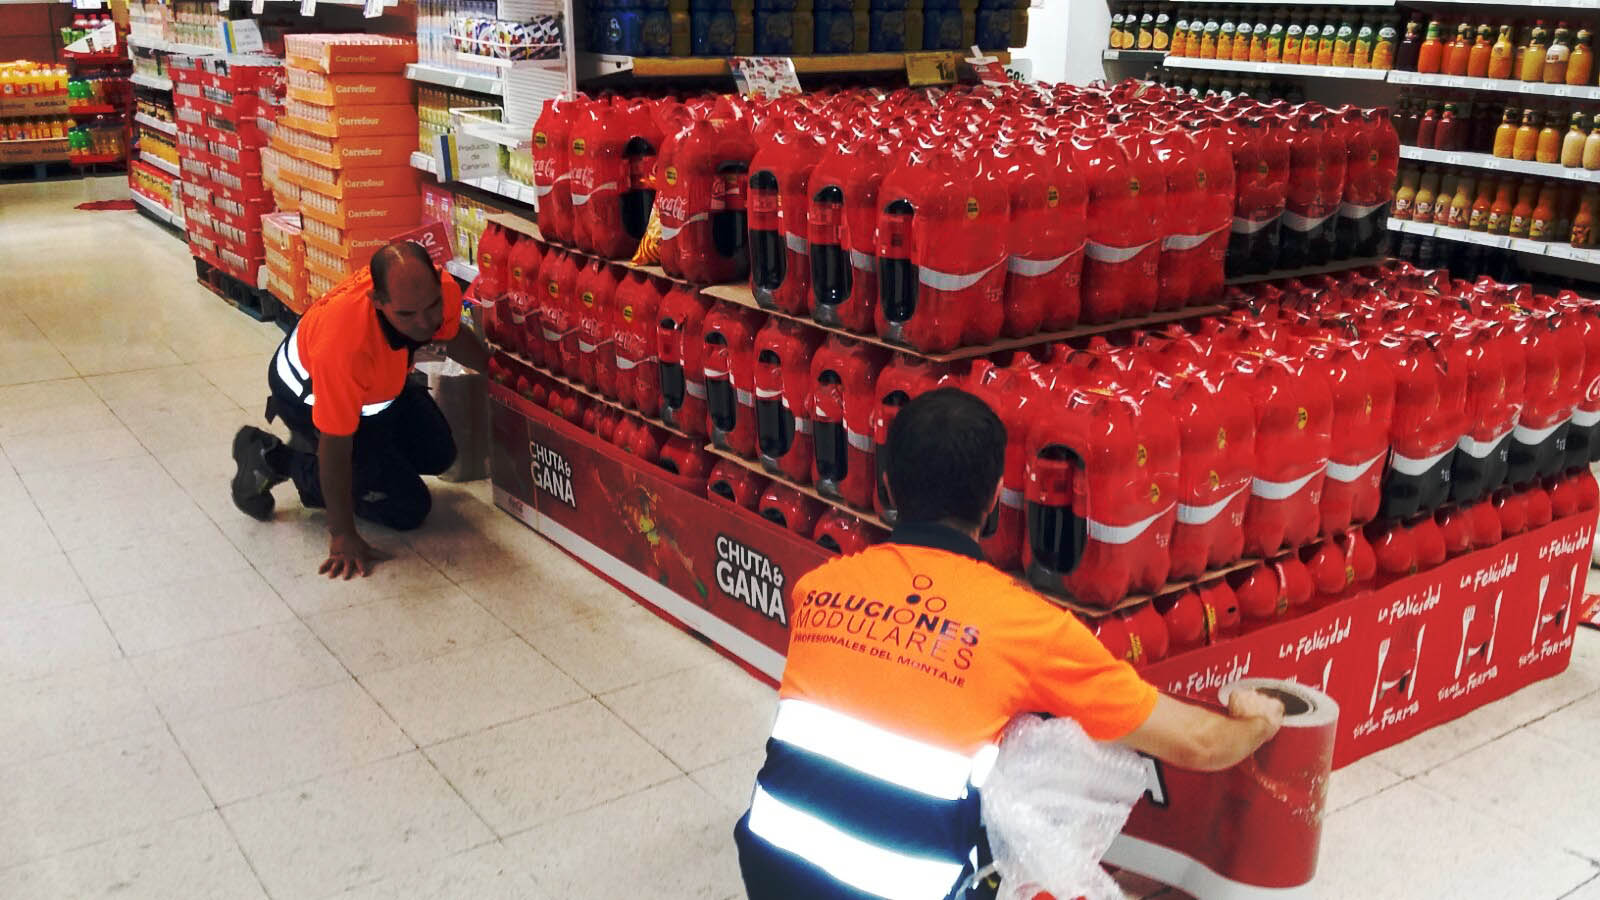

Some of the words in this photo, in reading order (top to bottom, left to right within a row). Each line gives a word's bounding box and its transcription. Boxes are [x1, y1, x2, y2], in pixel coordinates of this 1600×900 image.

[335, 84, 377, 93] Carrefour
[338, 116, 380, 126] Carrefour
[342, 147, 383, 157] Carrefour
[344, 178, 385, 188] Carrefour
[348, 208, 389, 218] Carrefour
[529, 440, 572, 477] CHUTA&
[531, 461, 576, 508] GANA
[716, 536, 784, 587] CHUTA&
[1473, 552, 1519, 592] Felicidad
[716, 560, 786, 625] GANA
[1389, 583, 1441, 624] Felicidad
[796, 608, 974, 671] MODULARES
[803, 590, 980, 648] SOLUCIONES
[1295, 615, 1352, 663] Felicidad
[869, 646, 893, 662] DEL
[896, 655, 966, 688] MONTAJE
